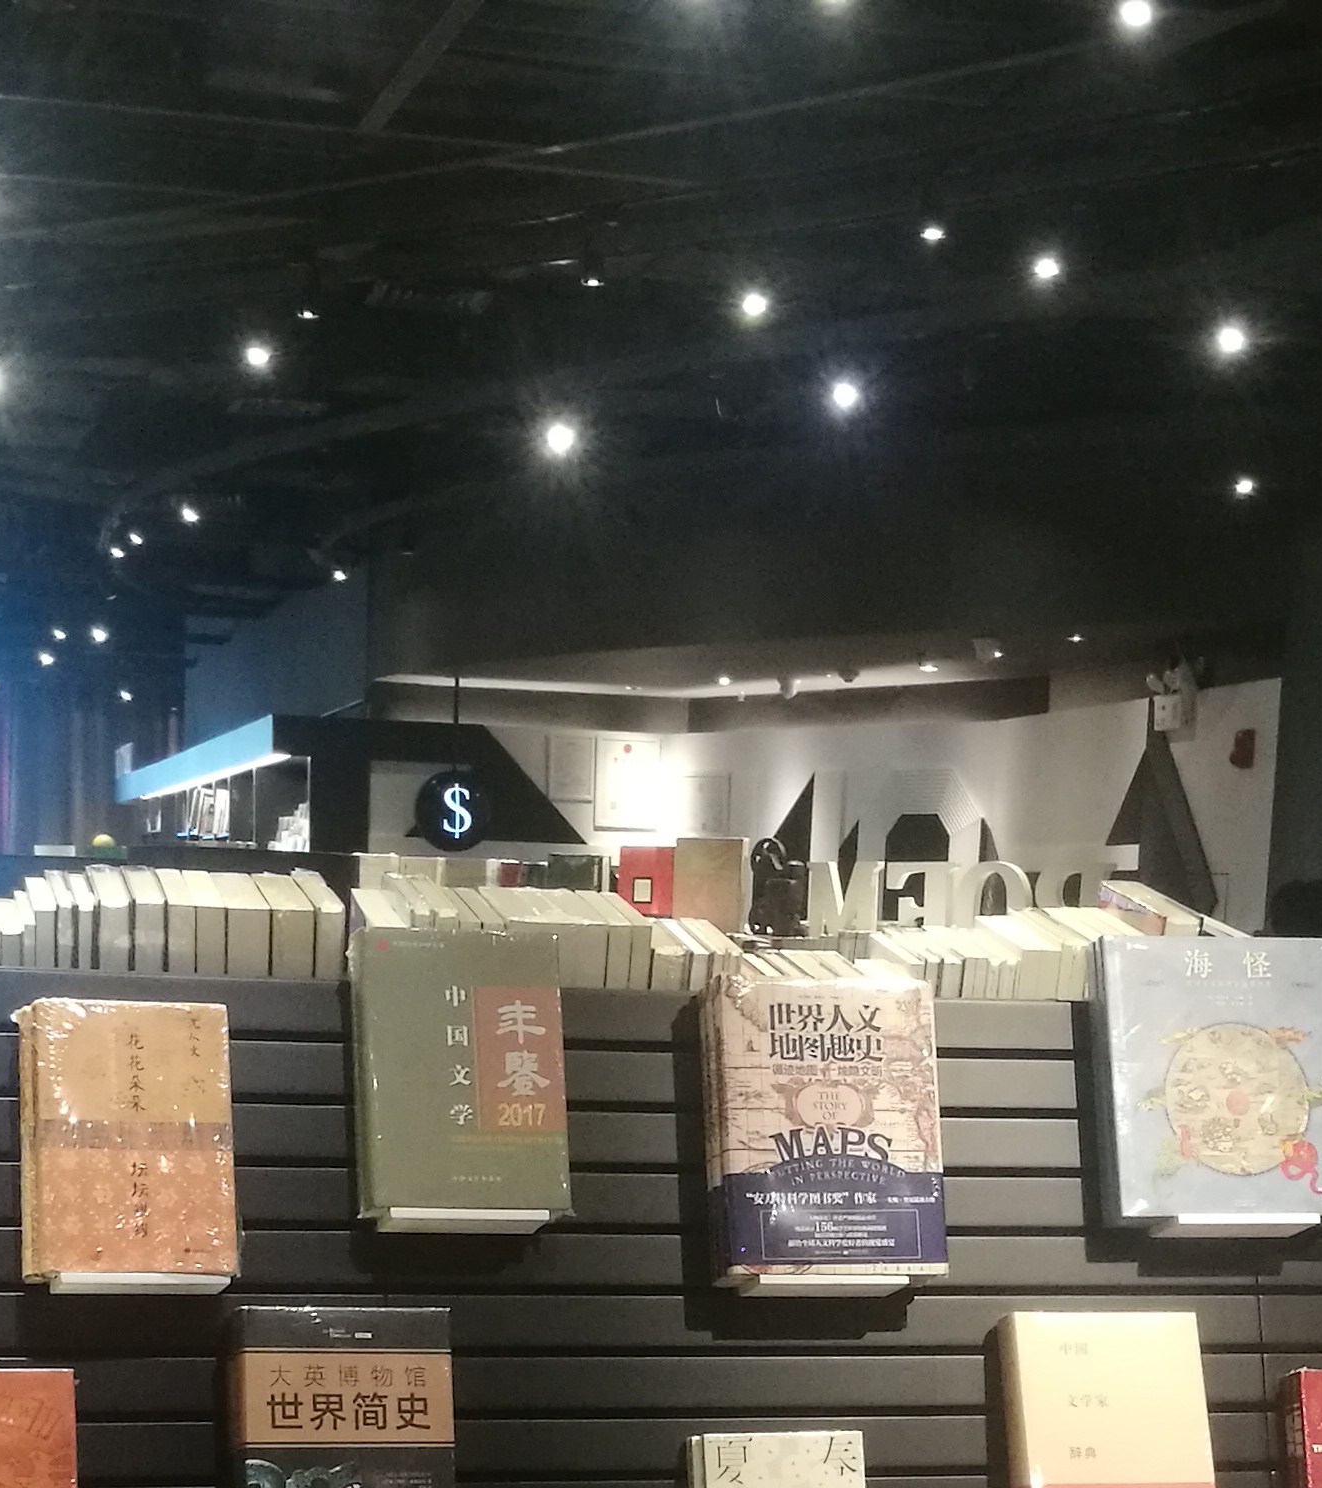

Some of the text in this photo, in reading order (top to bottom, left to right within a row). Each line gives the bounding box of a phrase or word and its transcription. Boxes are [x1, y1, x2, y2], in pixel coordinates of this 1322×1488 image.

[1184, 949, 1272, 979] 海怪
[769, 1002, 882, 1033] 世界人文
[444, 984, 474, 1126] 中国文学
[769, 1032, 885, 1062] 地图趣史
[813, 1101, 847, 1112] STORY
[818, 1090, 840, 1101] THE
[498, 1102, 547, 1127] 2017
[822, 1111, 837, 1121] OF
[769, 1126, 892, 1163] MAPS
[769, 1157, 906, 1180] UTTING THE WORLD
[1059, 1342, 1089, 1356] 中国
[270, 1364, 427, 1388] 大英博物馆
[267, 1392, 431, 1430] 世界简史
[1067, 1393, 1110, 1408] 文学家
[1069, 1446, 1097, 1460] 辞典
